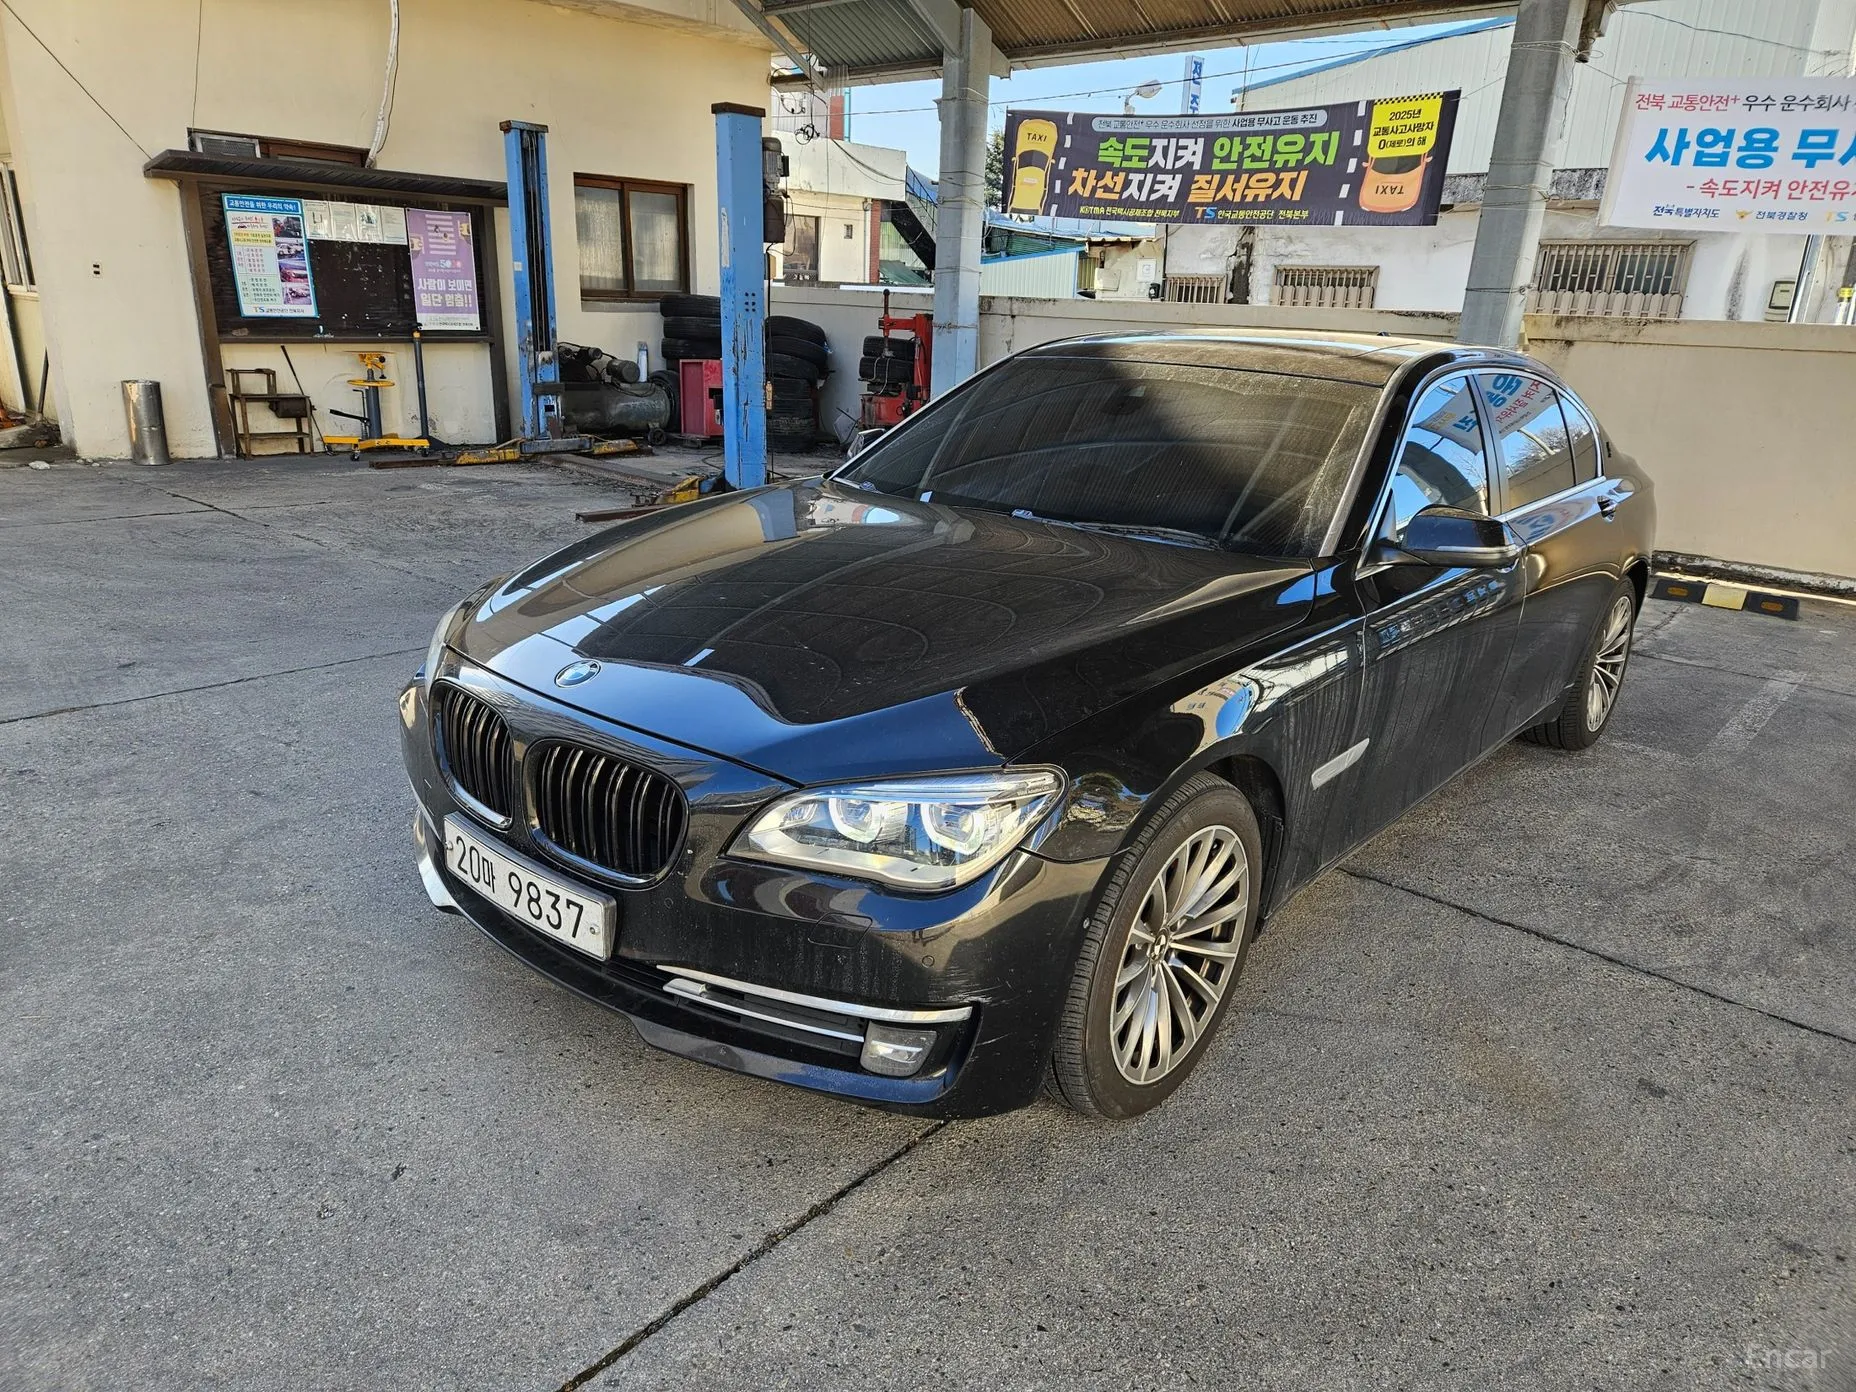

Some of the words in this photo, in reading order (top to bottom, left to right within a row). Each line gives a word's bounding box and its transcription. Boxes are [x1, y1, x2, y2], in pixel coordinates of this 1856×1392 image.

[1635, 93, 1666, 112] 전북
[1668, 93, 1741, 112] 교통안전+
[1742, 94, 1776, 112] 우수
[1780, 94, 1851, 112] 운수회사
[1098, 119, 1112, 129] 전북
[1145, 119, 1159, 129] 우수
[1161, 119, 1190, 129] 운수회사
[1191, 118, 1213, 129] 선정을
[1215, 118, 1231, 129] 위한
[1232, 117, 1256, 128] 사업용
[1257, 116, 1281, 127] 무사고
[1282, 114, 1299, 126] 운동
[1300, 113, 1318, 124] 추진
[1389, 109, 1422, 121] 2025년
[1373, 121, 1434, 137] 교통사고사망자
[1027, 132, 1048, 142] TAXI
[1416, 136, 1427, 146] 해
[1097, 136, 1205, 170] 속도지켜
[1211, 131, 1341, 170] 안전유지
[1644, 127, 1781, 169] 사업용
[1068, 167, 1183, 202] 차선지켜
[1187, 169, 1309, 203] 질서유지
[1375, 184, 1405, 194] TAXI
[1699, 178, 1783, 200] 속도지켜
[1787, 179, 1856, 201] 안전유
[255, 200, 268, 208] 위한
[1194, 206, 1218, 219] TS
[1278, 209, 1309, 220] 전북본부
[1755, 210, 1809, 222] 전북경찰청
[417, 278, 446, 291] 사람이
[447, 279, 473, 292] 보이면
[420, 293, 443, 307] 일단
[455, 835, 496, 894] 20마
[508, 871, 584, 939] 9837
